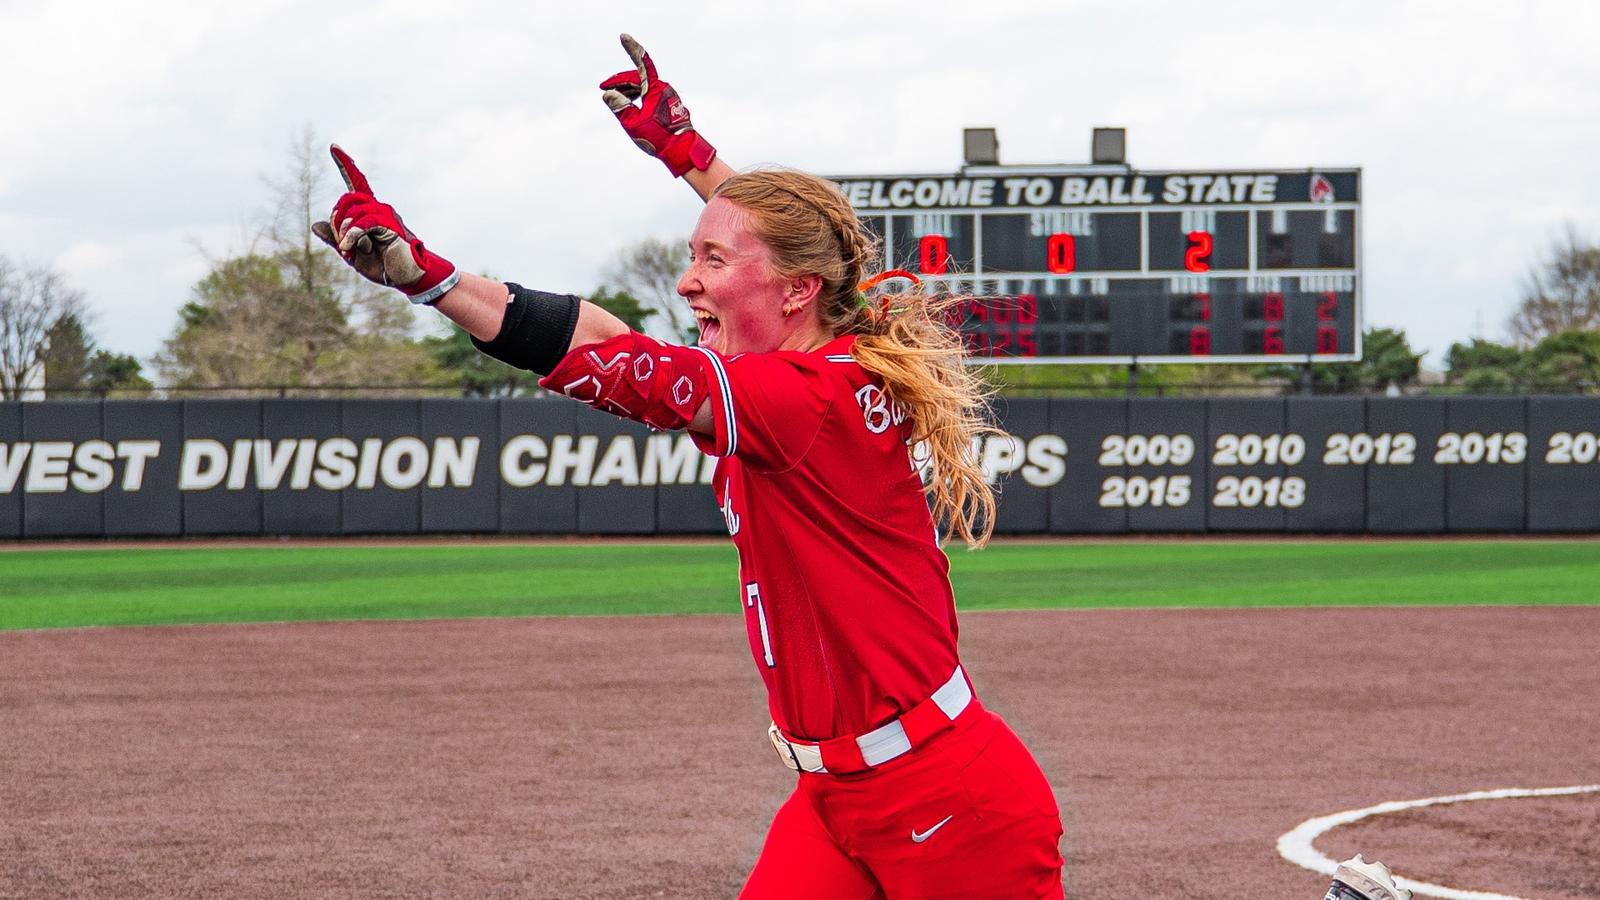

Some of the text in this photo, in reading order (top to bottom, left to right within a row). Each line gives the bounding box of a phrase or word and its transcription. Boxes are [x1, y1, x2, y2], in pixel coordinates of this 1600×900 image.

[1004, 178, 1053, 205] TO
[1060, 177, 1154, 204] BALL
[1162, 175, 1278, 203] STATE
[919, 230, 1213, 276] 0 0 2
[179, 437, 480, 490] DIVISION
[1099, 434, 1195, 466] 2009
[1212, 433, 1306, 465] 2010
[1323, 433, 1416, 464] 2012
[1434, 432, 1528, 464] 2013
[1099, 475, 1306, 508] 2015 2018
[746, 581, 776, 668] 7
